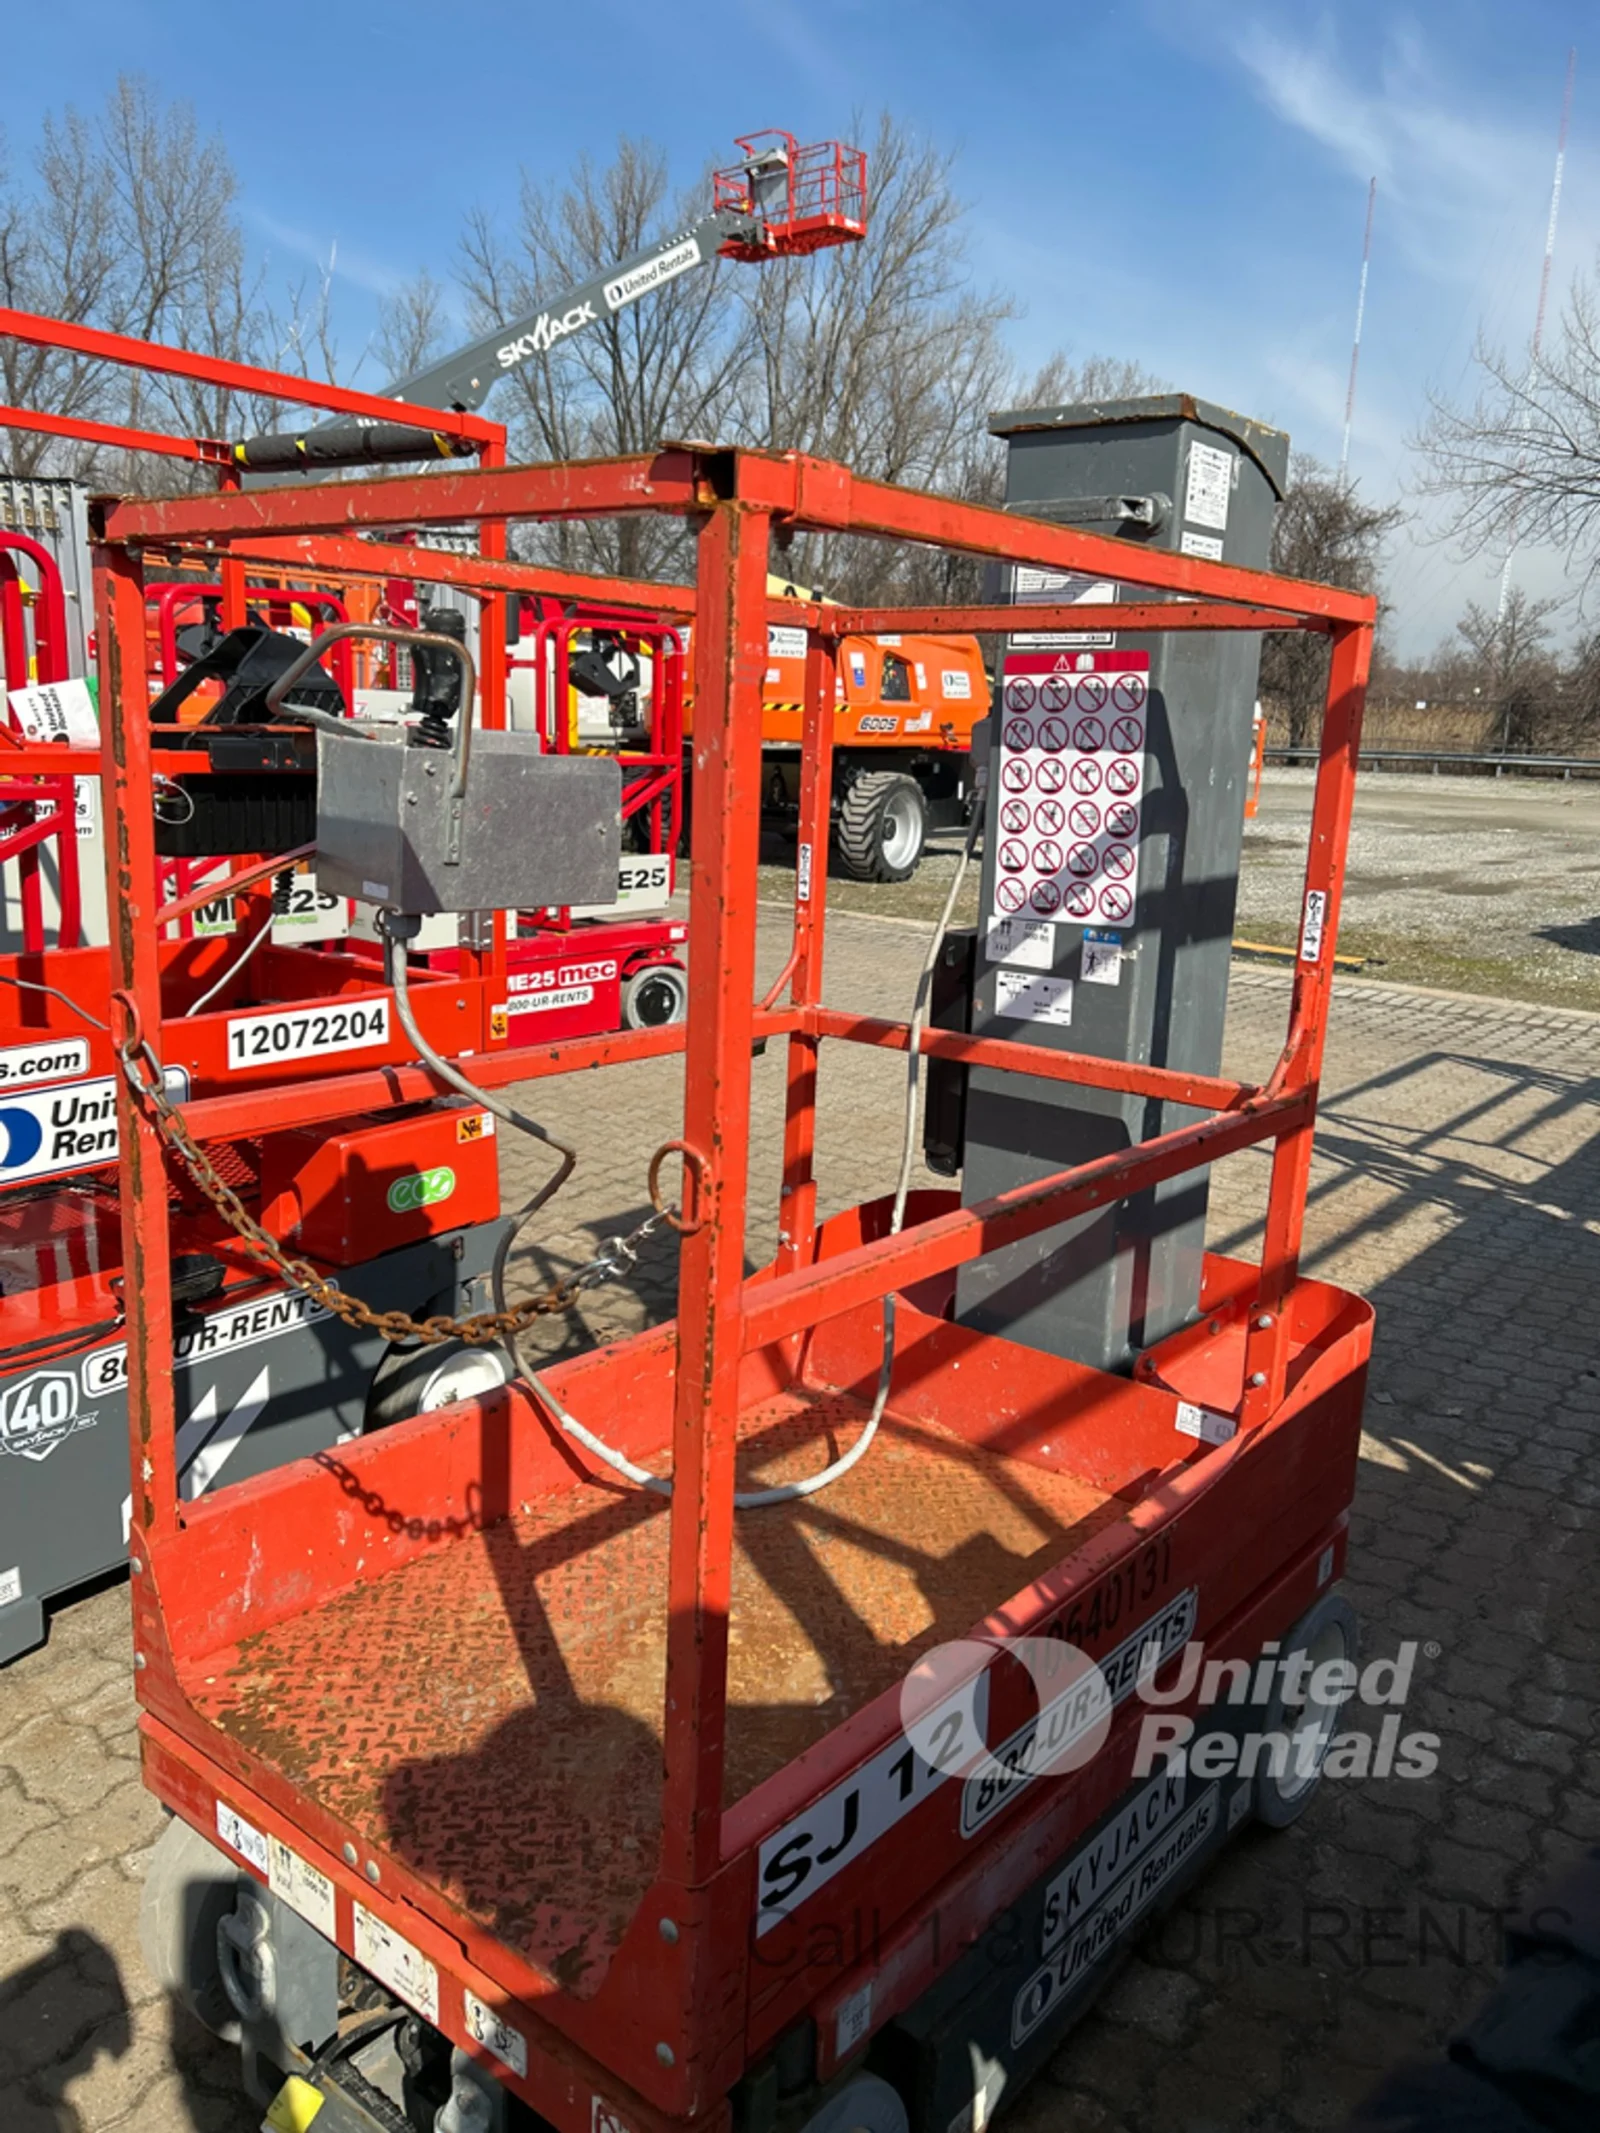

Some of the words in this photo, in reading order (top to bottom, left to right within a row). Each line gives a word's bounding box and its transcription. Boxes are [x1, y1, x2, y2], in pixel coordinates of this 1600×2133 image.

[623, 262, 659, 296] United
[658, 248, 695, 279] Rentals
[496, 300, 597, 368] SKYJACK
[560, 962, 615, 985] mec
[231, 1008, 386, 1059] 12072204
[9, 1379, 69, 1434] 40
[976, 1600, 1190, 1814] 800-UR-RENTS
[761, 1788, 860, 1911] SJ
[887, 1709, 965, 1803] 12
[1043, 1775, 1179, 1939] SKYJACK
[1058, 1890, 1135, 1987] United
[1138, 1805, 1210, 1900] Rentals
